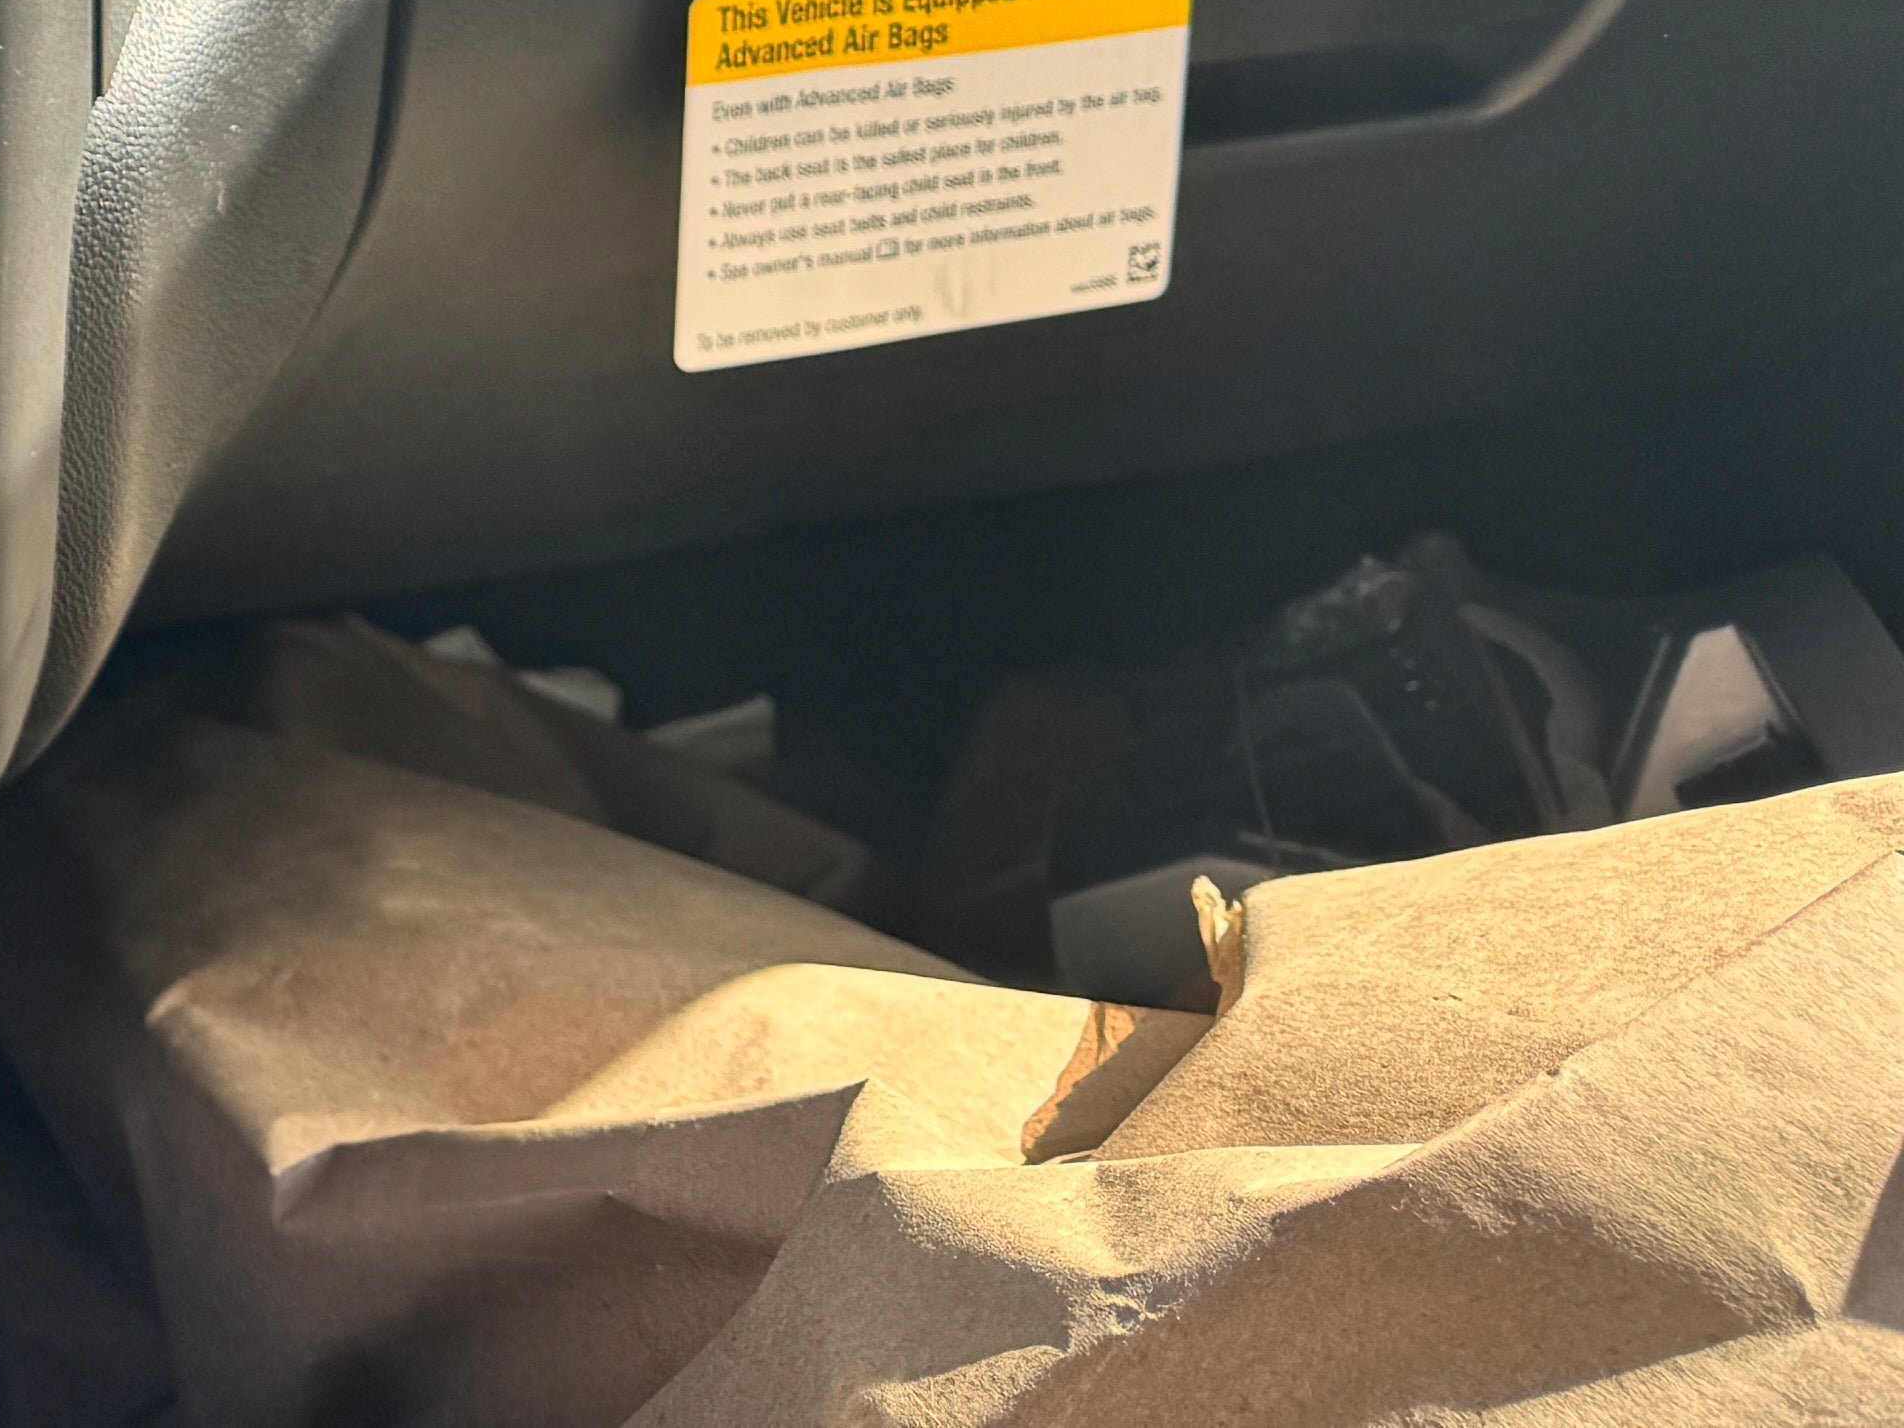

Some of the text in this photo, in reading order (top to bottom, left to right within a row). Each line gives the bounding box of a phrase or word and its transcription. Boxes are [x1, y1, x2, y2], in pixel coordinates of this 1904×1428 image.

[716, 1, 768, 33] This
[714, 15, 950, 71] Advanced Air Bags
